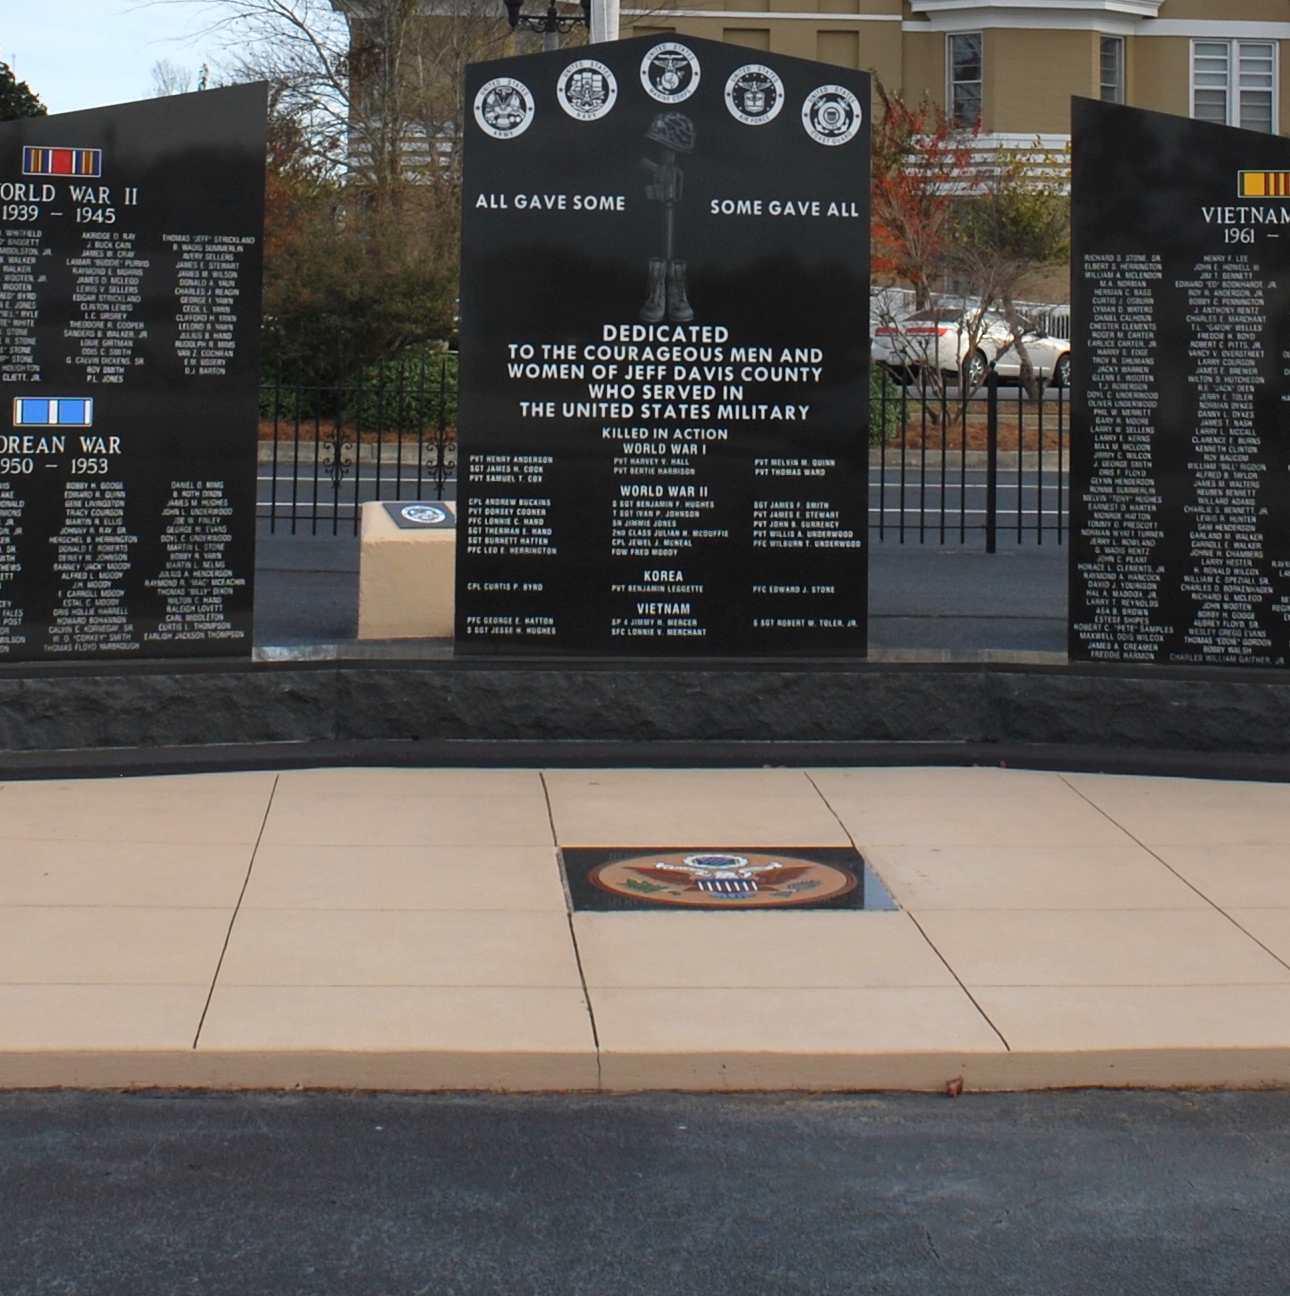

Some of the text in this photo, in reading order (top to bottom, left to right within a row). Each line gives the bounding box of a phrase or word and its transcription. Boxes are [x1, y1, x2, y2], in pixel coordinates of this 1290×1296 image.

[647, 44, 695, 61] UNITED STATES
[564, 61, 612, 79] UNITED STATES
[731, 66, 779, 83] UNITED STATES
[481, 79, 529, 97] UNITED STATES
[649, 88, 692, 102] MARINE CORPS
[809, 87, 856, 103] UNITED STATES
[739, 114, 770, 123] AIR FORCE
[811, 131, 852, 144] COAST GUARD
[69, 185, 110, 204] WAR
[124, 187, 137, 205] II
[475, 193, 625, 210] ALL GAVE SOME
[2, 204, 38, 221] 1939
[76, 206, 115, 223] 1945
[710, 199, 858, 216] SOME GAVE ALL
[1224, 227, 1254, 243] 1961
[603, 324, 728, 343] DEDICATED
[508, 344, 822, 363] TO THE COURAGEOUS MEN AND
[507, 363, 822, 382] WOMEN OF JEFF DAVIS COUNTY
[588, 383, 743, 400] WHO SERVED IN
[519, 401, 809, 420] THE UNITED STATES MILITARY
[602, 427, 727, 439] KILLED IN ACTION
[79, 436, 121, 454] WAR
[623, 442, 706, 454] WORLD WAR I
[71, 458, 108, 474] 1953
[620, 484, 707, 497] WORLD WAR II
[644, 570, 683, 581] KOREA
[467, 582, 480, 590] CPL
[637, 602, 690, 614] VIETNAM
